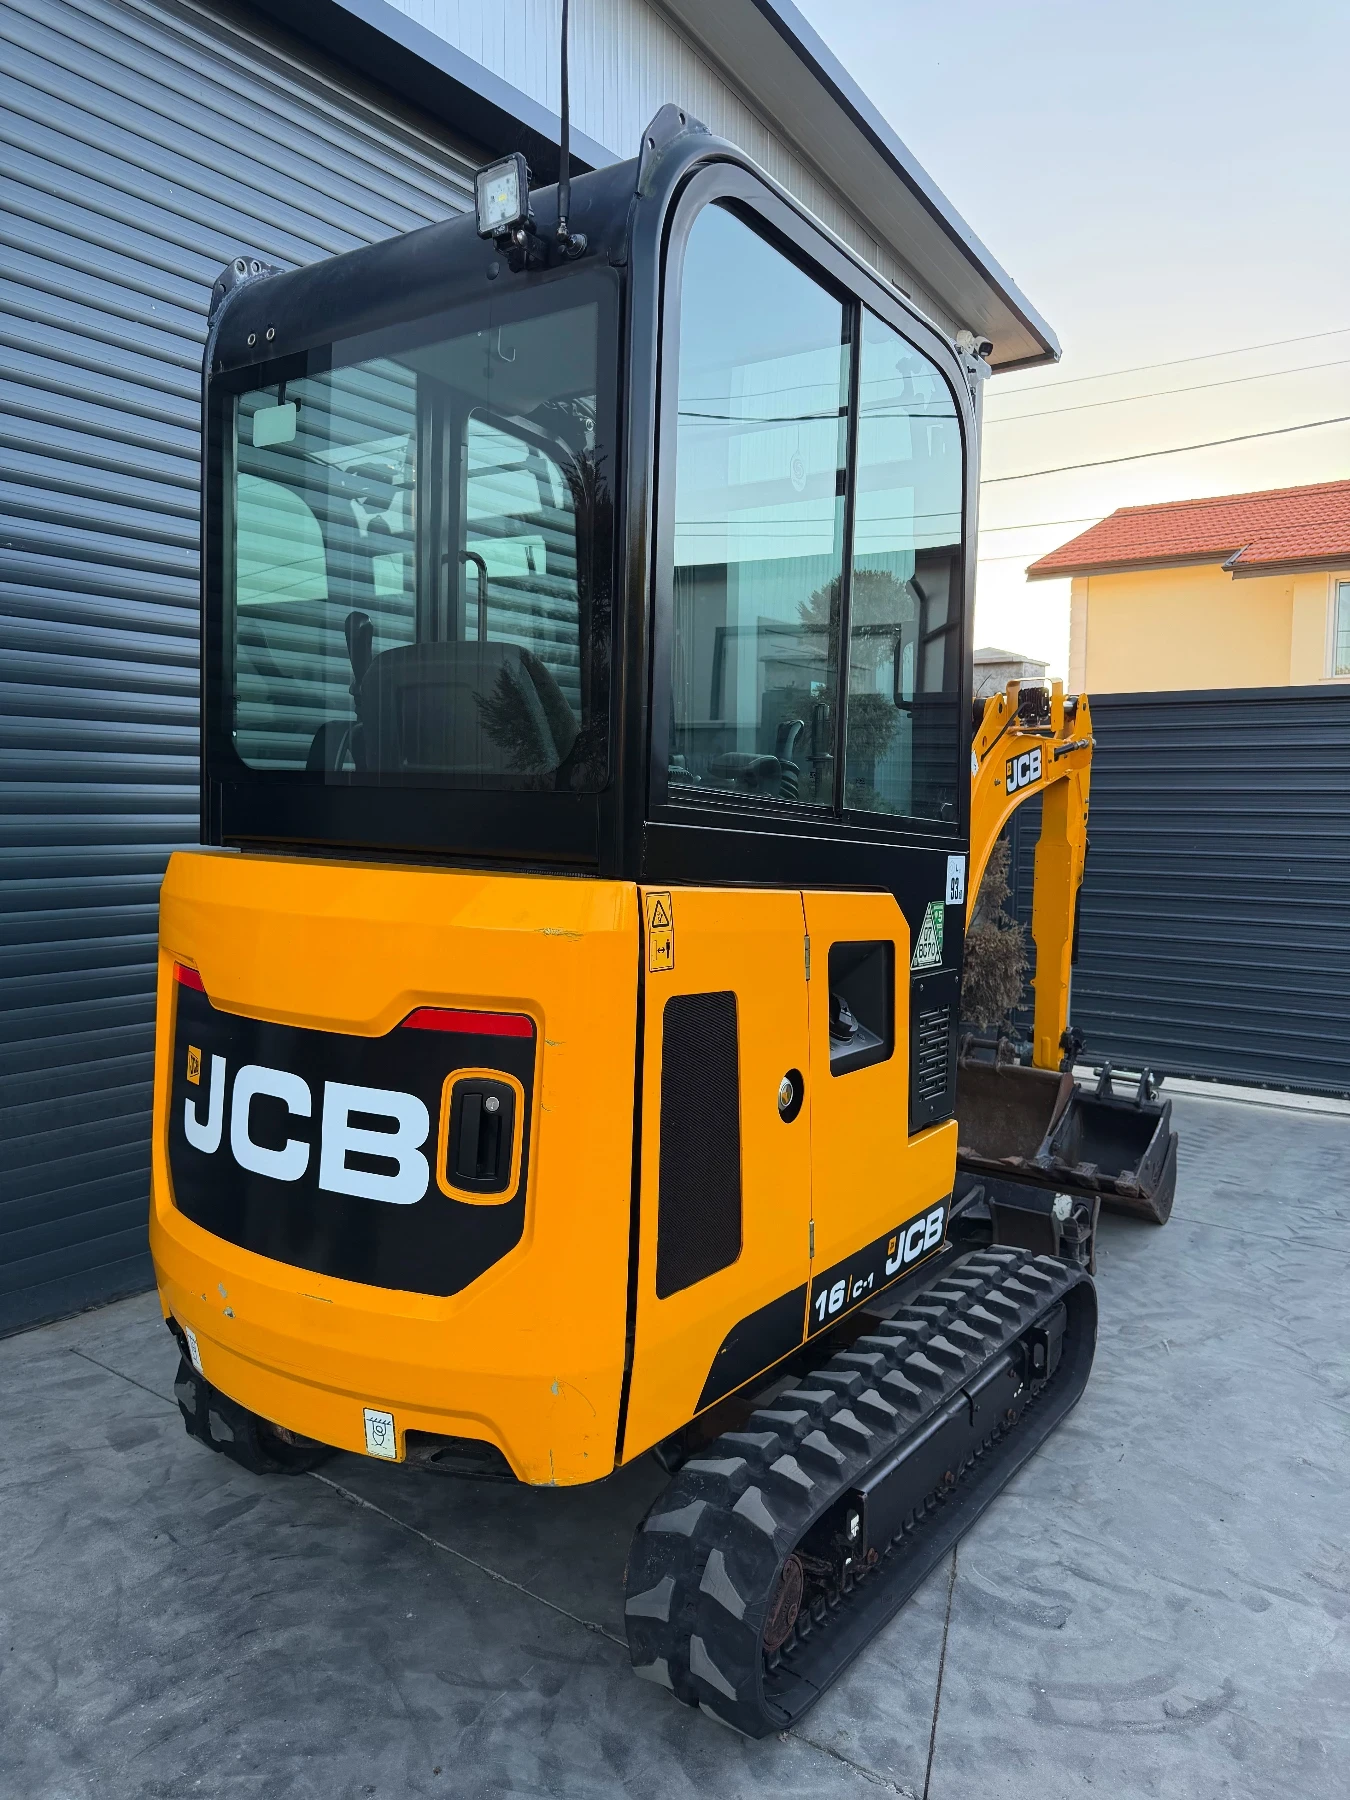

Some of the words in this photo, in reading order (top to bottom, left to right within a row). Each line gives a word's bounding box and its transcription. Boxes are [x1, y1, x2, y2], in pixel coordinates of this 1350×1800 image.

[1007, 749, 1041, 792] JCB
[950, 877, 959, 900] 93
[184, 1054, 430, 1205] JCB
[885, 1207, 945, 1276] JCB
[815, 1279, 846, 1322] 16
[852, 1272, 874, 1298] C-1
